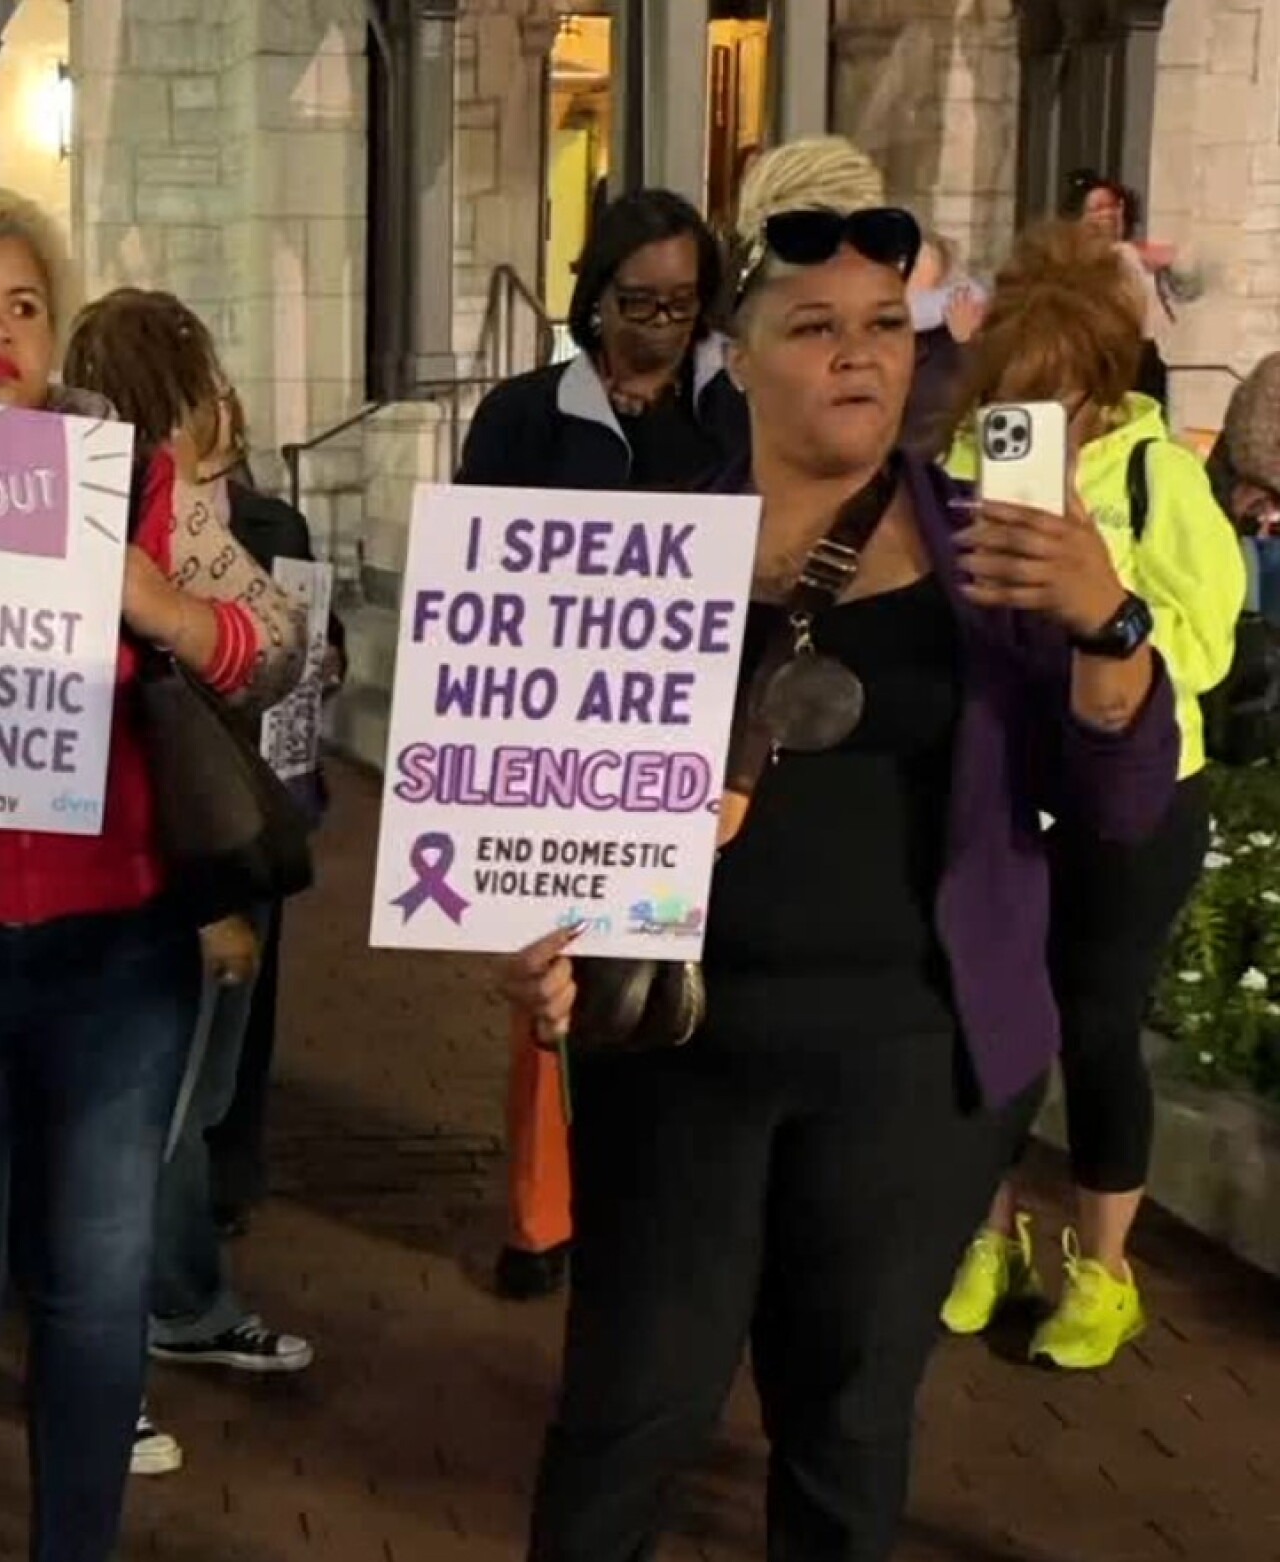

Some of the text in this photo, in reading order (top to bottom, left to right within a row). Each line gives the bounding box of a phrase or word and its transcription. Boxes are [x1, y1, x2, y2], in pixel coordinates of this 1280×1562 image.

[466, 516, 696, 578] I SPEAK
[412, 590, 735, 653] FOR THOSE
[435, 664, 695, 725] WHO ARE
[393, 742, 720, 815] SILENCED.
[477, 836, 678, 868] END DOMESTIC
[475, 870, 607, 899] VIOLENCE
[556, 906, 612, 934] dn
